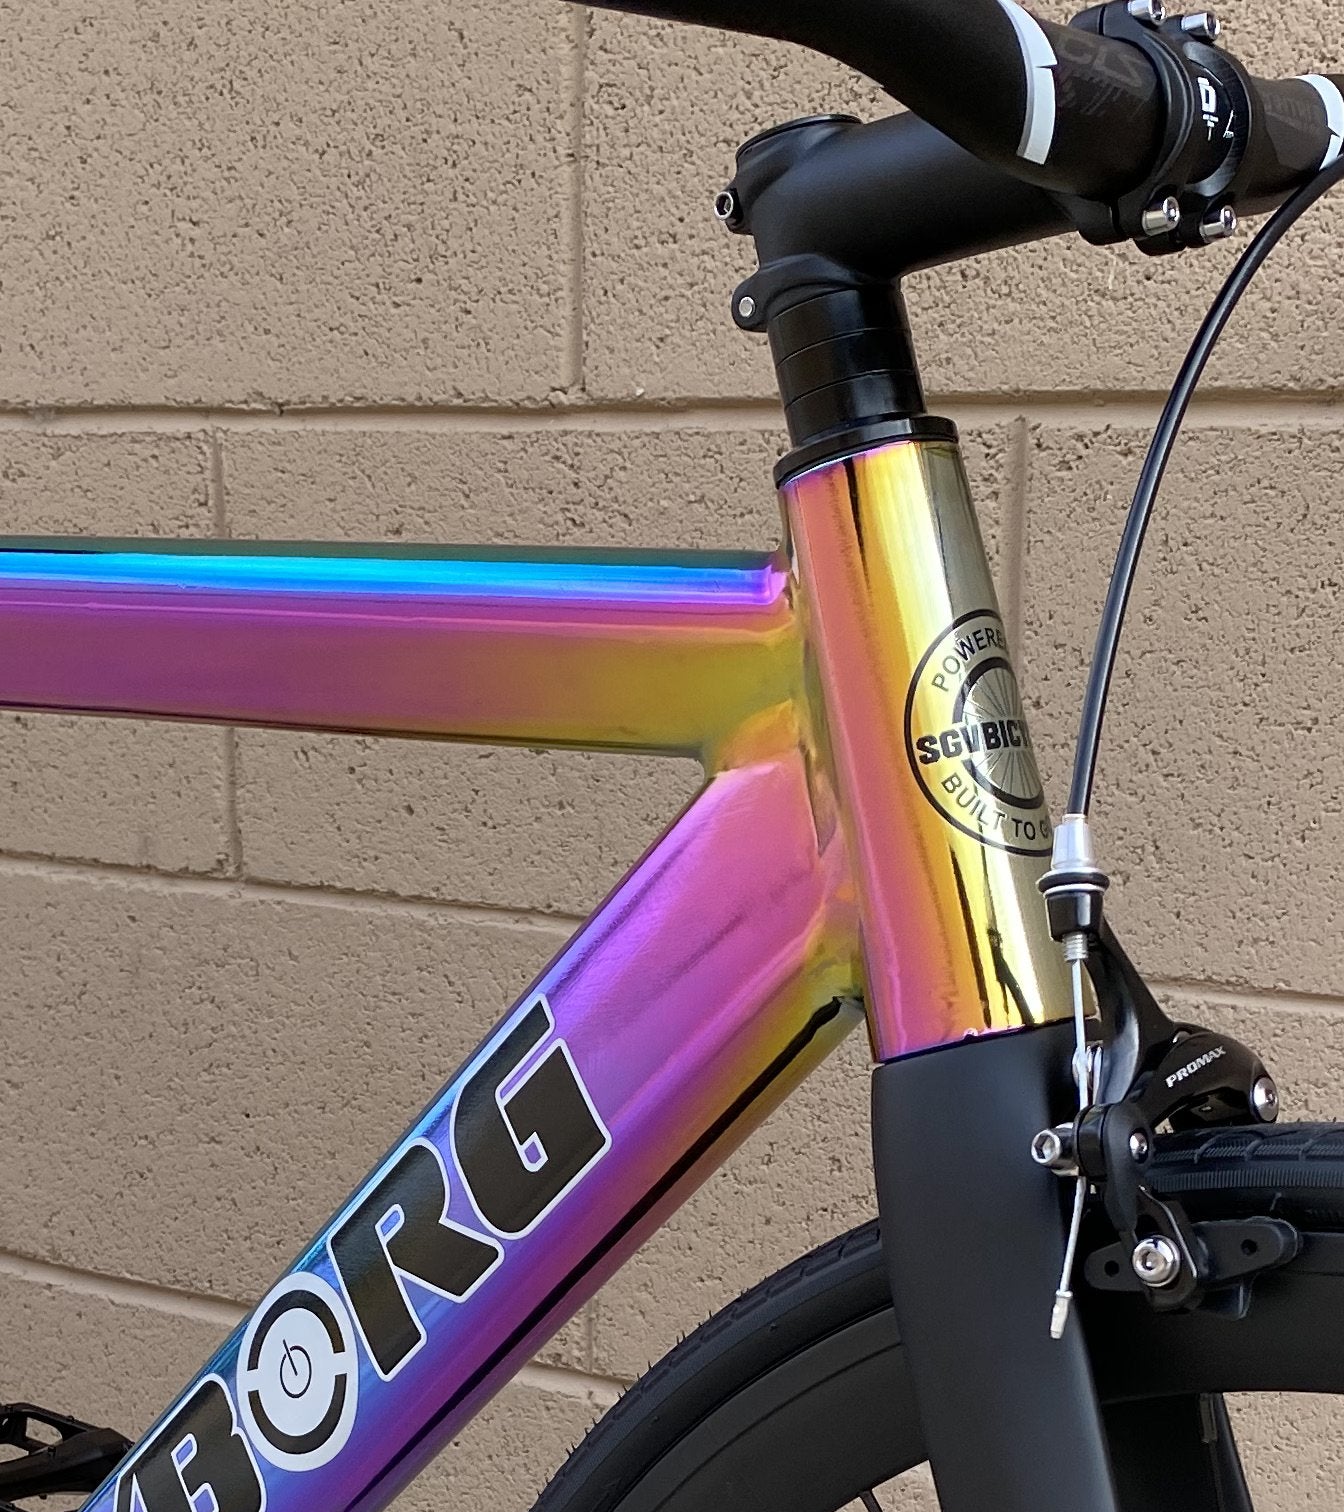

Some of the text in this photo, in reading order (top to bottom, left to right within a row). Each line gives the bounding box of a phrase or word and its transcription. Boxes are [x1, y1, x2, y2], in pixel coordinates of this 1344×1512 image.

[941, 772, 1006, 830] BUILT
[1011, 817, 1036, 841] TO
[1165, 1045, 1227, 1090] PROMAX
